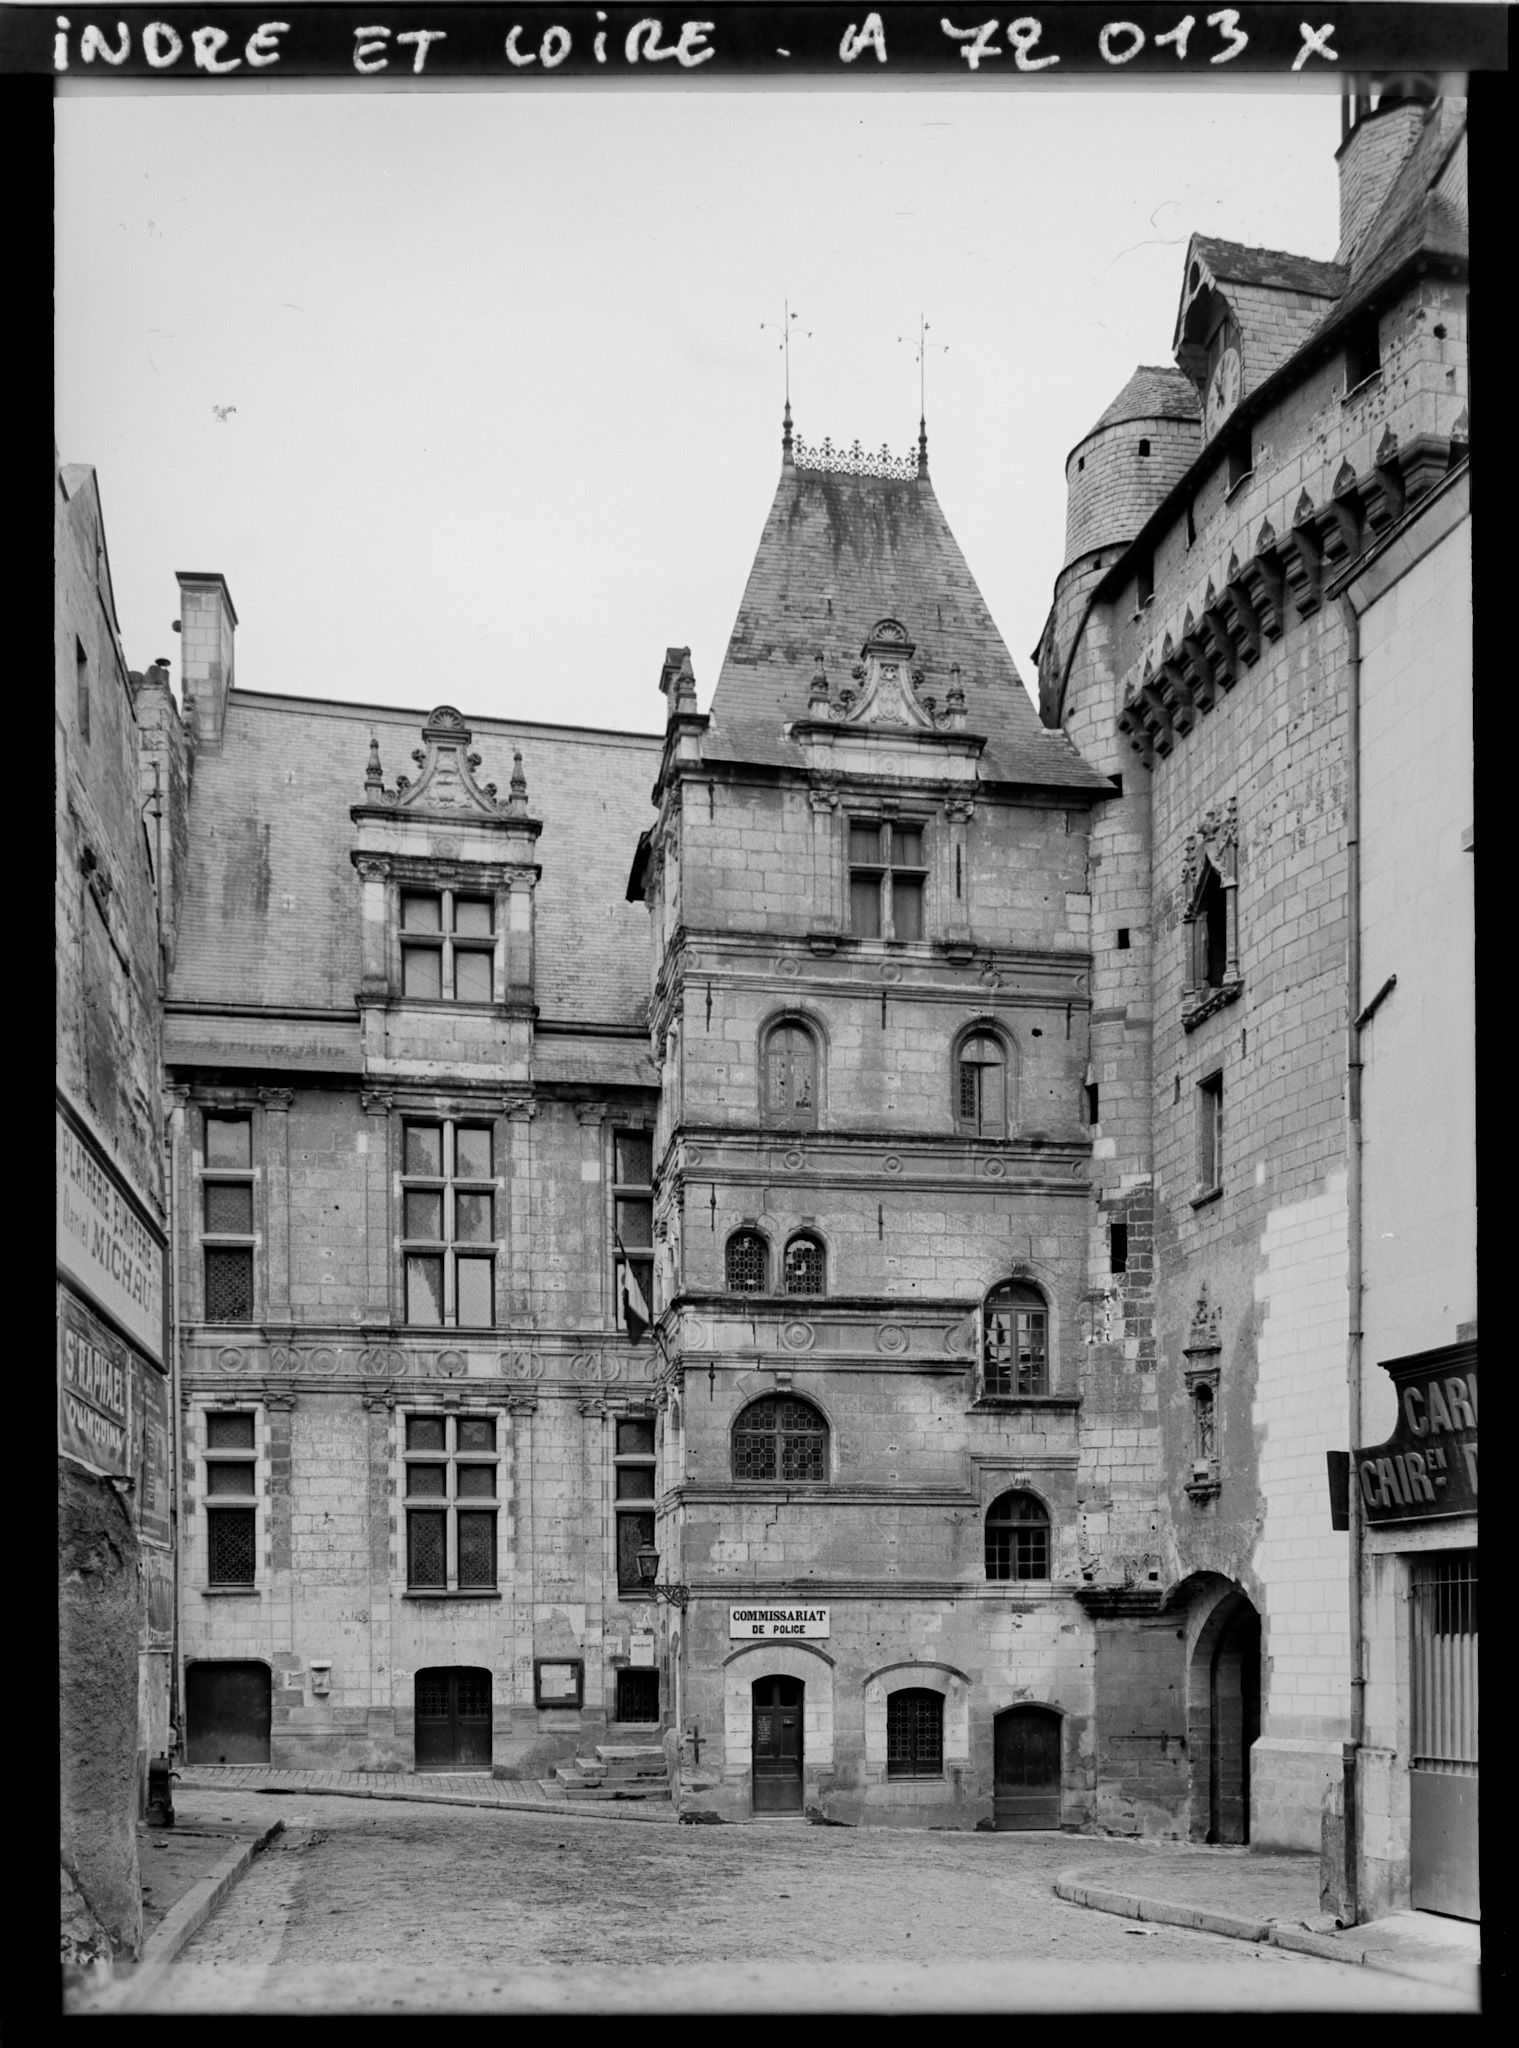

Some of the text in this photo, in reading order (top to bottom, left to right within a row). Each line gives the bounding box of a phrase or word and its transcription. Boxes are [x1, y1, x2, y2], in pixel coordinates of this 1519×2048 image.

[91, 1216, 152, 1313] MICHAU
[732, 1610, 826, 1622] COMMISSARIAT
[752, 1624, 806, 1634] DE POLICE
